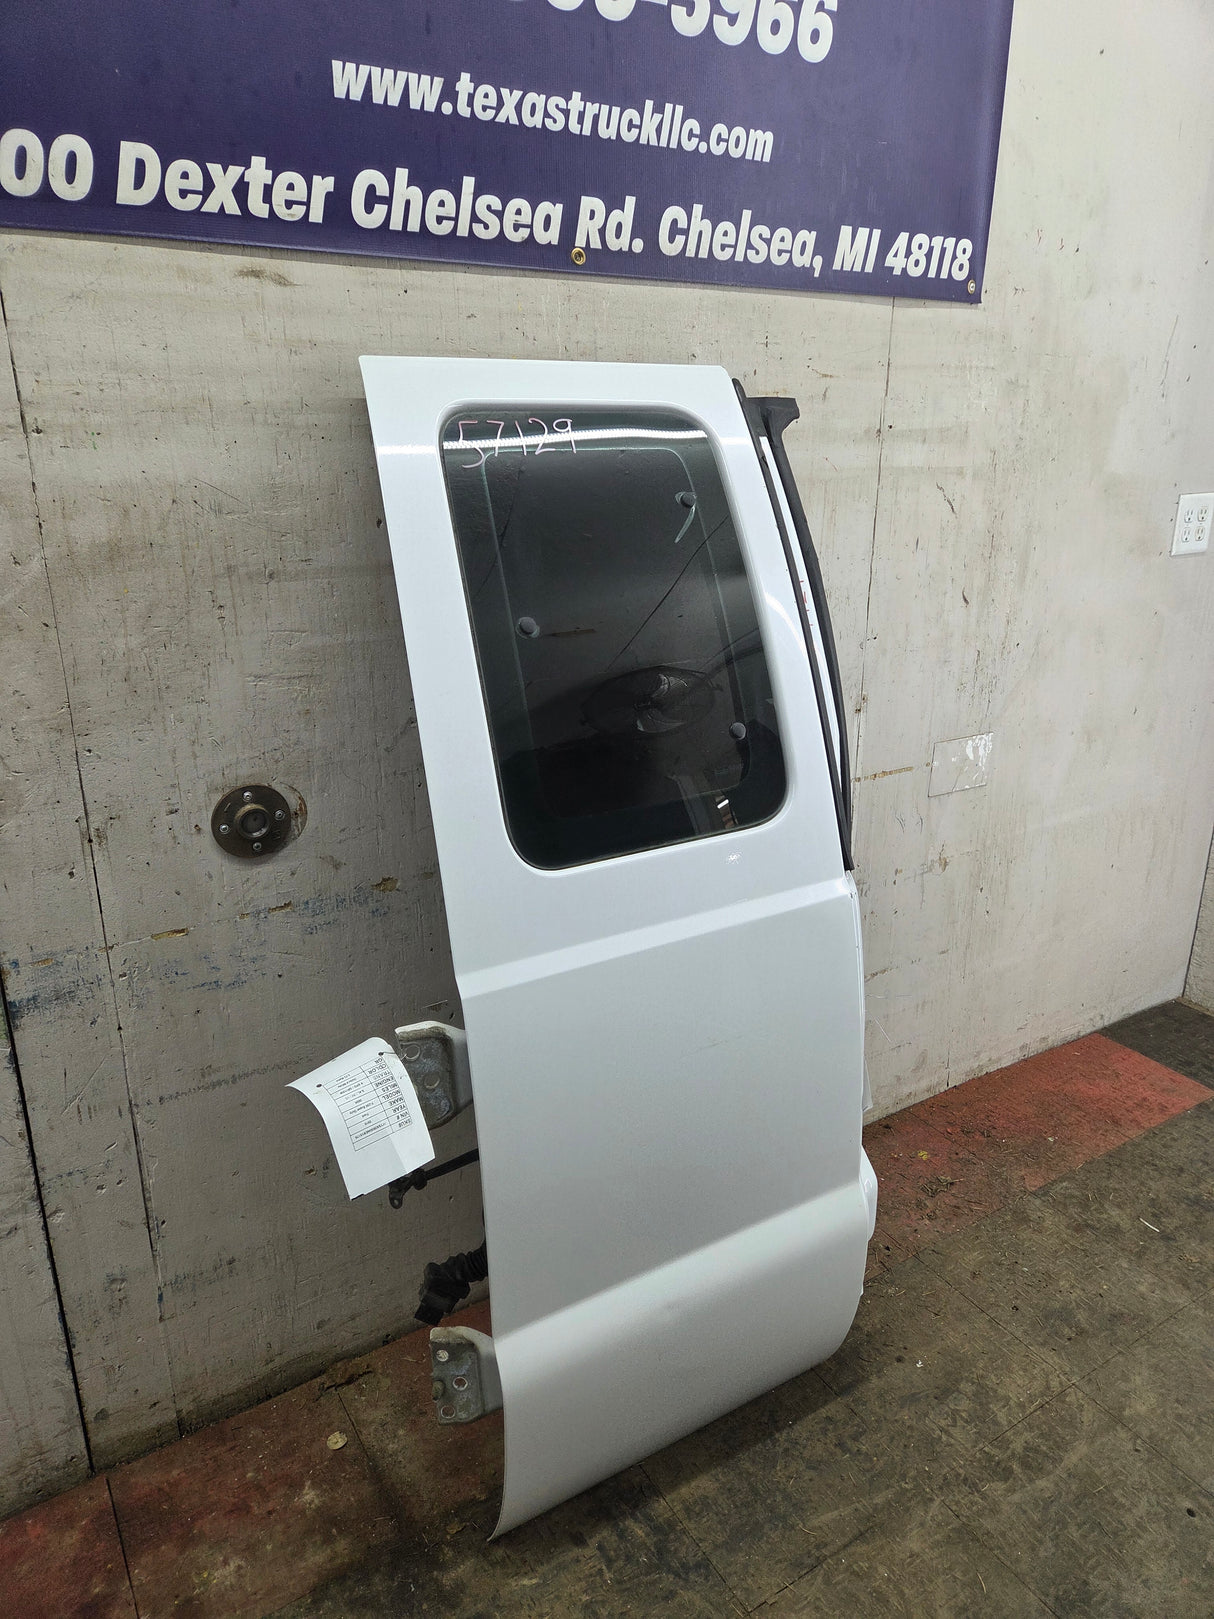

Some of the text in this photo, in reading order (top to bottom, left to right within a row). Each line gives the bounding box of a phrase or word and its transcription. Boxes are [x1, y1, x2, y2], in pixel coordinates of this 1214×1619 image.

[332, 59, 773, 163] www.texastruckllc.com
[116, 140, 335, 224] Dexter
[350, 167, 563, 245] Chelsea
[574, 195, 644, 254] Rd.
[658, 203, 823, 278] Chelsea,
[833, 224, 881, 274] MI
[884, 231, 973, 281] 48118
[457, 417, 577, 469] 57129
[368, 1064, 387, 1074] COLOR
[382, 1089, 401, 1100] MODEL
[389, 1097, 404, 1106] MAKE
[392, 1104, 406, 1113] YEAR
